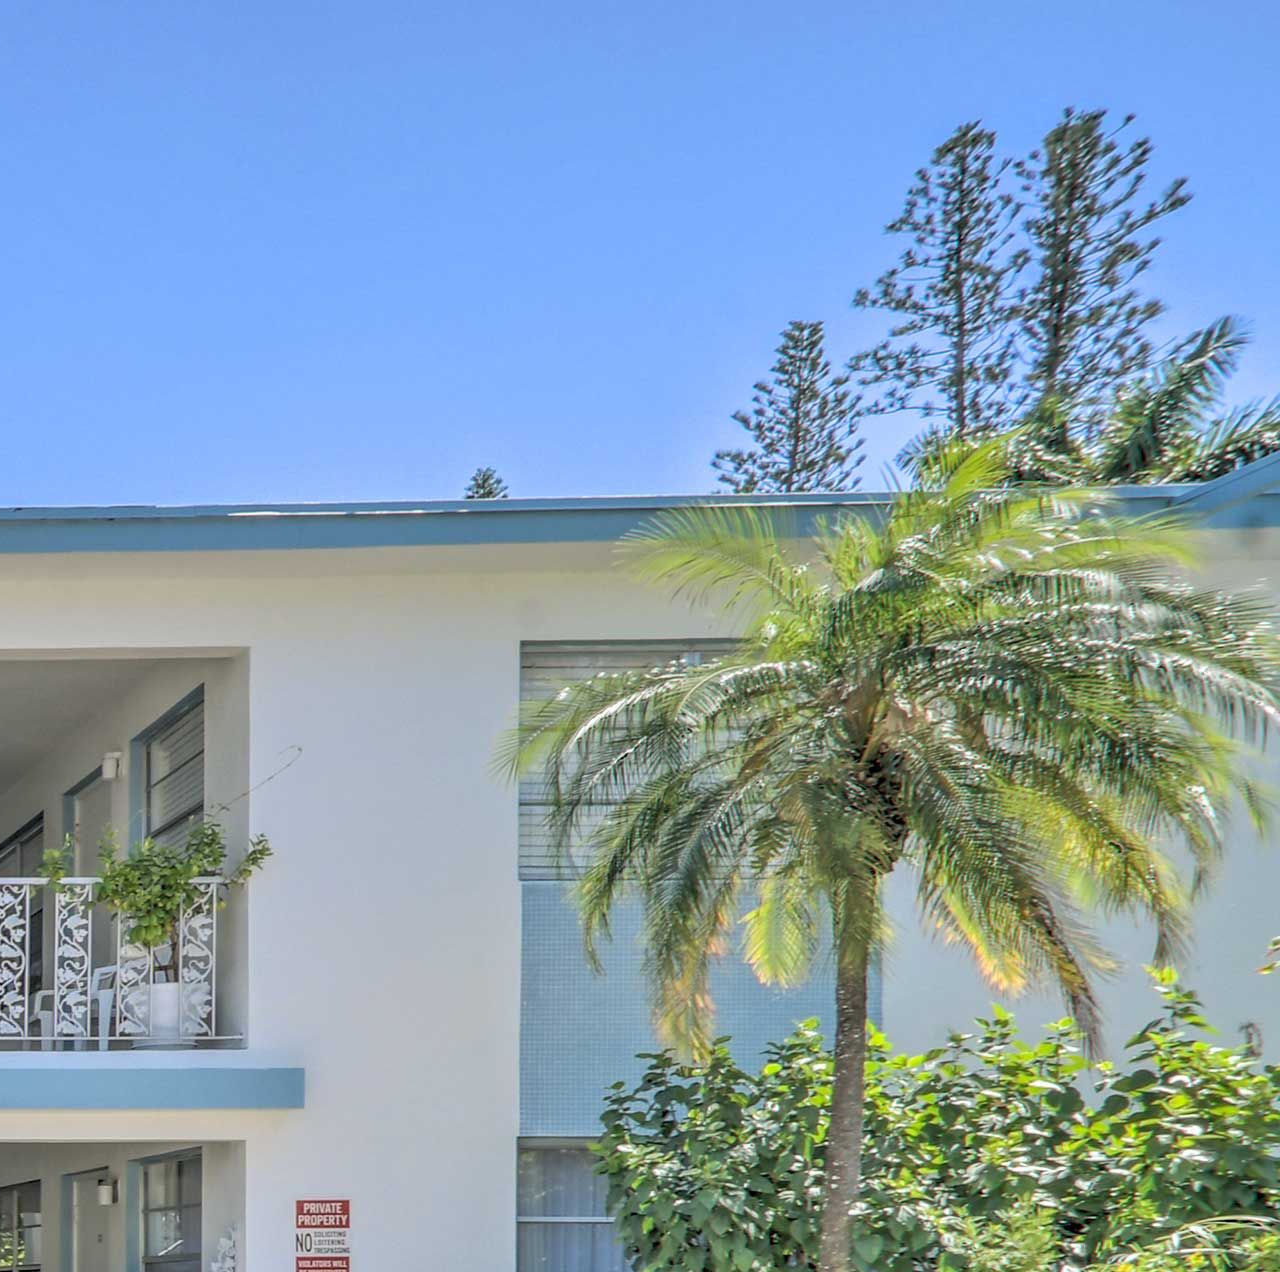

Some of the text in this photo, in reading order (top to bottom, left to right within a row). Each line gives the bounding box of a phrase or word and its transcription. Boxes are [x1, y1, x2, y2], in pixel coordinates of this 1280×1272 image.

[303, 1202, 343, 1214] PRIVATE
[298, 1214, 348, 1226] PROPERTY
[296, 1233, 313, 1253] NO
[298, 1260, 347, 1268] VIOLATORS WILL
